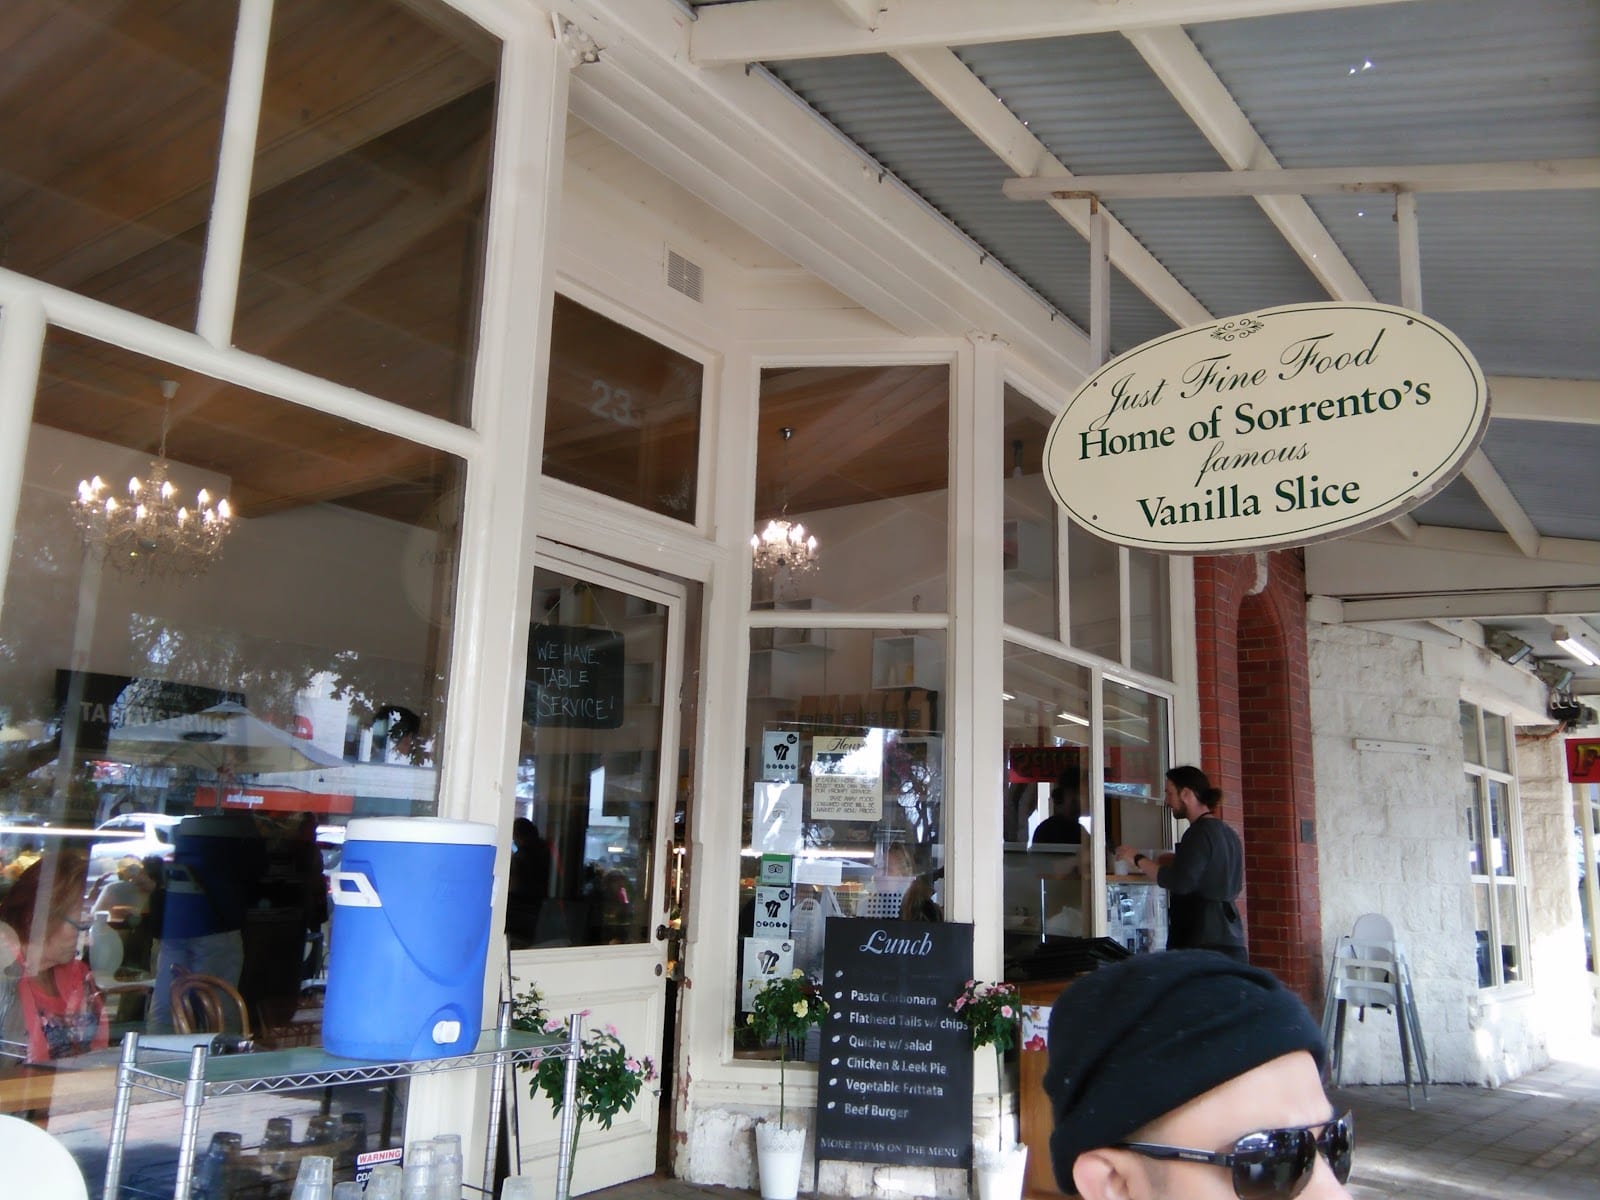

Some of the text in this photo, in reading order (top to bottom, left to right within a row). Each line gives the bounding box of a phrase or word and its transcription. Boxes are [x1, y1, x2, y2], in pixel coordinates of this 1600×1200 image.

[1088, 328, 1386, 432] Just Fine Food
[590, 379, 632, 427] 23
[1078, 380, 1431, 461] Home of Sorrento's
[1194, 440, 1310, 488] famous
[1136, 474, 1360, 528] Vanilla Slice
[536, 640, 600, 664] WE HAVE
[536, 666, 589, 690] TABLE
[859, 929, 933, 956] Lunch
[851, 990, 937, 1006] Pasta Conara
[849, 1011, 896, 1026] Flathead
[940, 1018, 969, 1033] chips
[849, 1035, 886, 1049] Quiche
[903, 1040, 933, 1052] salad
[846, 1056, 947, 1075] Chicken & Leek Pie
[846, 1078, 944, 1097] Vegetable Frittata
[844, 1102, 909, 1120] Beef Burger
[359, 1150, 401, 1164] WARNING
[820, 1137, 851, 1149] MORE
[887, 1143, 902, 1153] ON
[905, 1144, 926, 1155] THE
[928, 1146, 959, 1158] MENU
